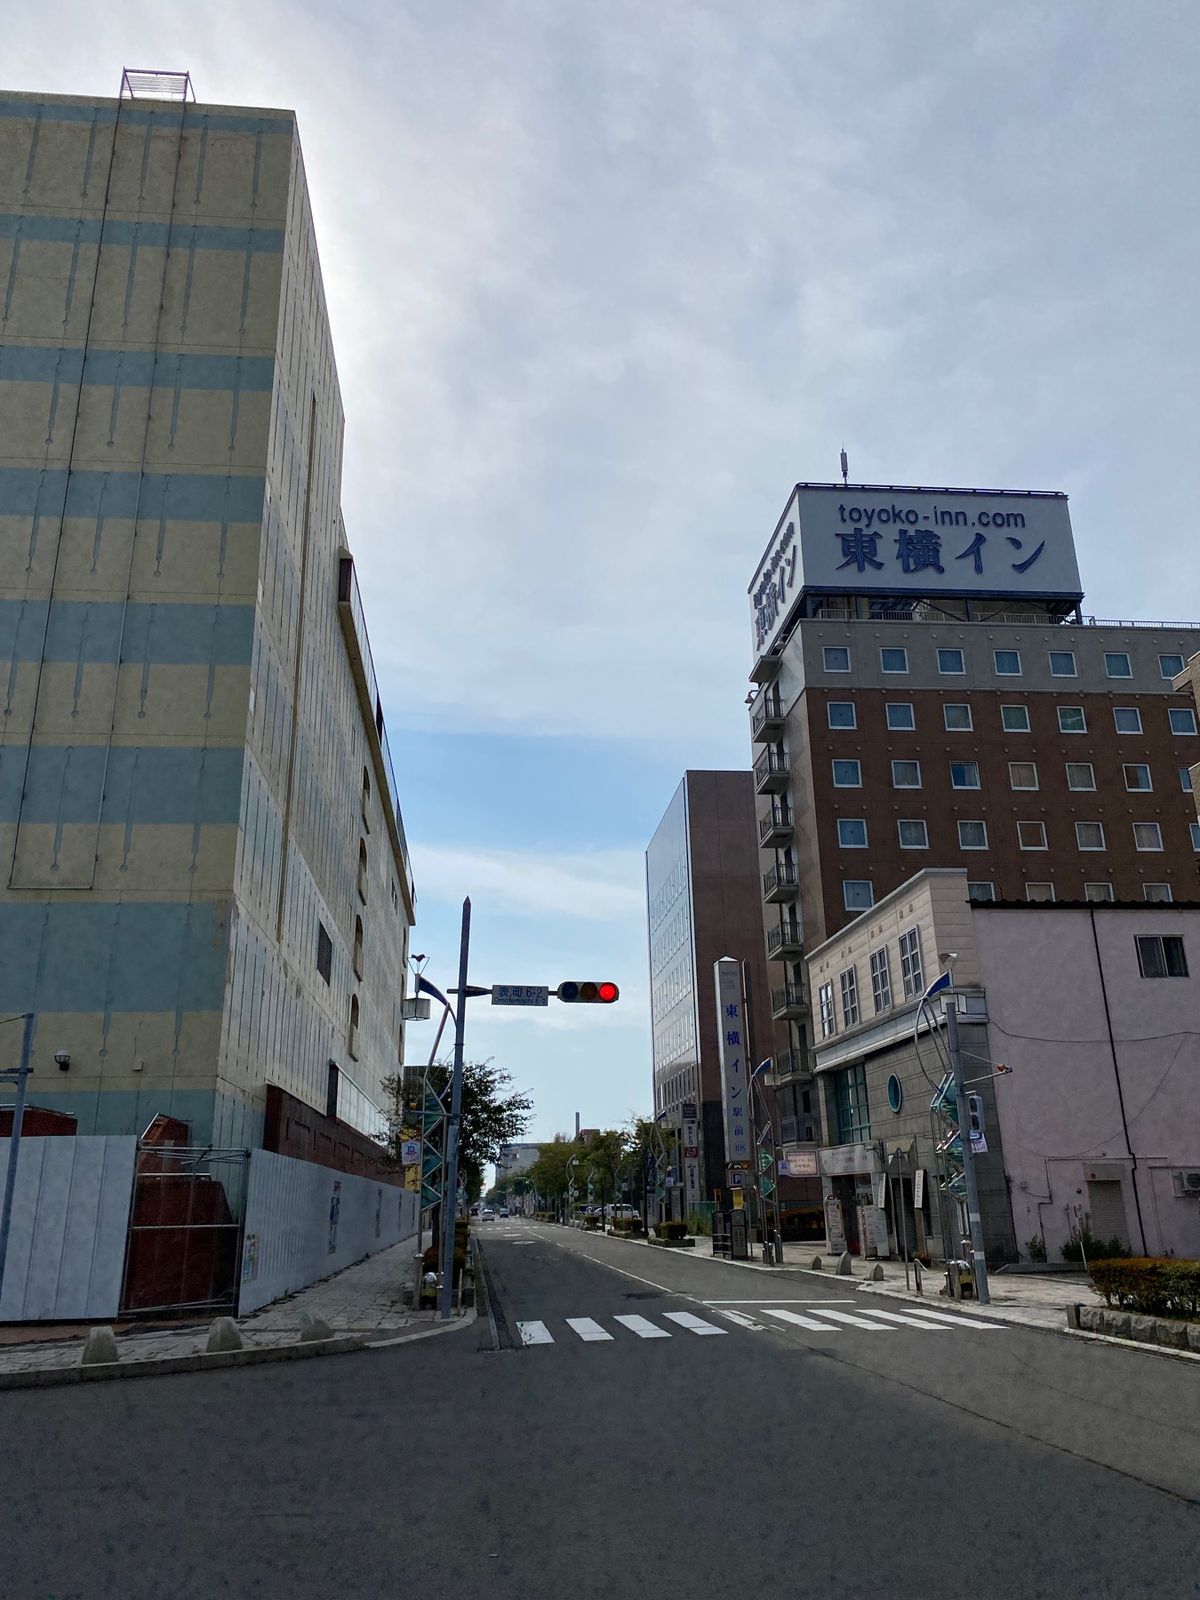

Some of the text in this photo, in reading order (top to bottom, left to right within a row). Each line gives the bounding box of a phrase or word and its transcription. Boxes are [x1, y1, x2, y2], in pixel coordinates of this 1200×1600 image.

[838, 503, 1026, 529] toyoko-inn.com
[834, 527, 1046, 575] 東横イン
[498, 986, 523, 998] 表町
